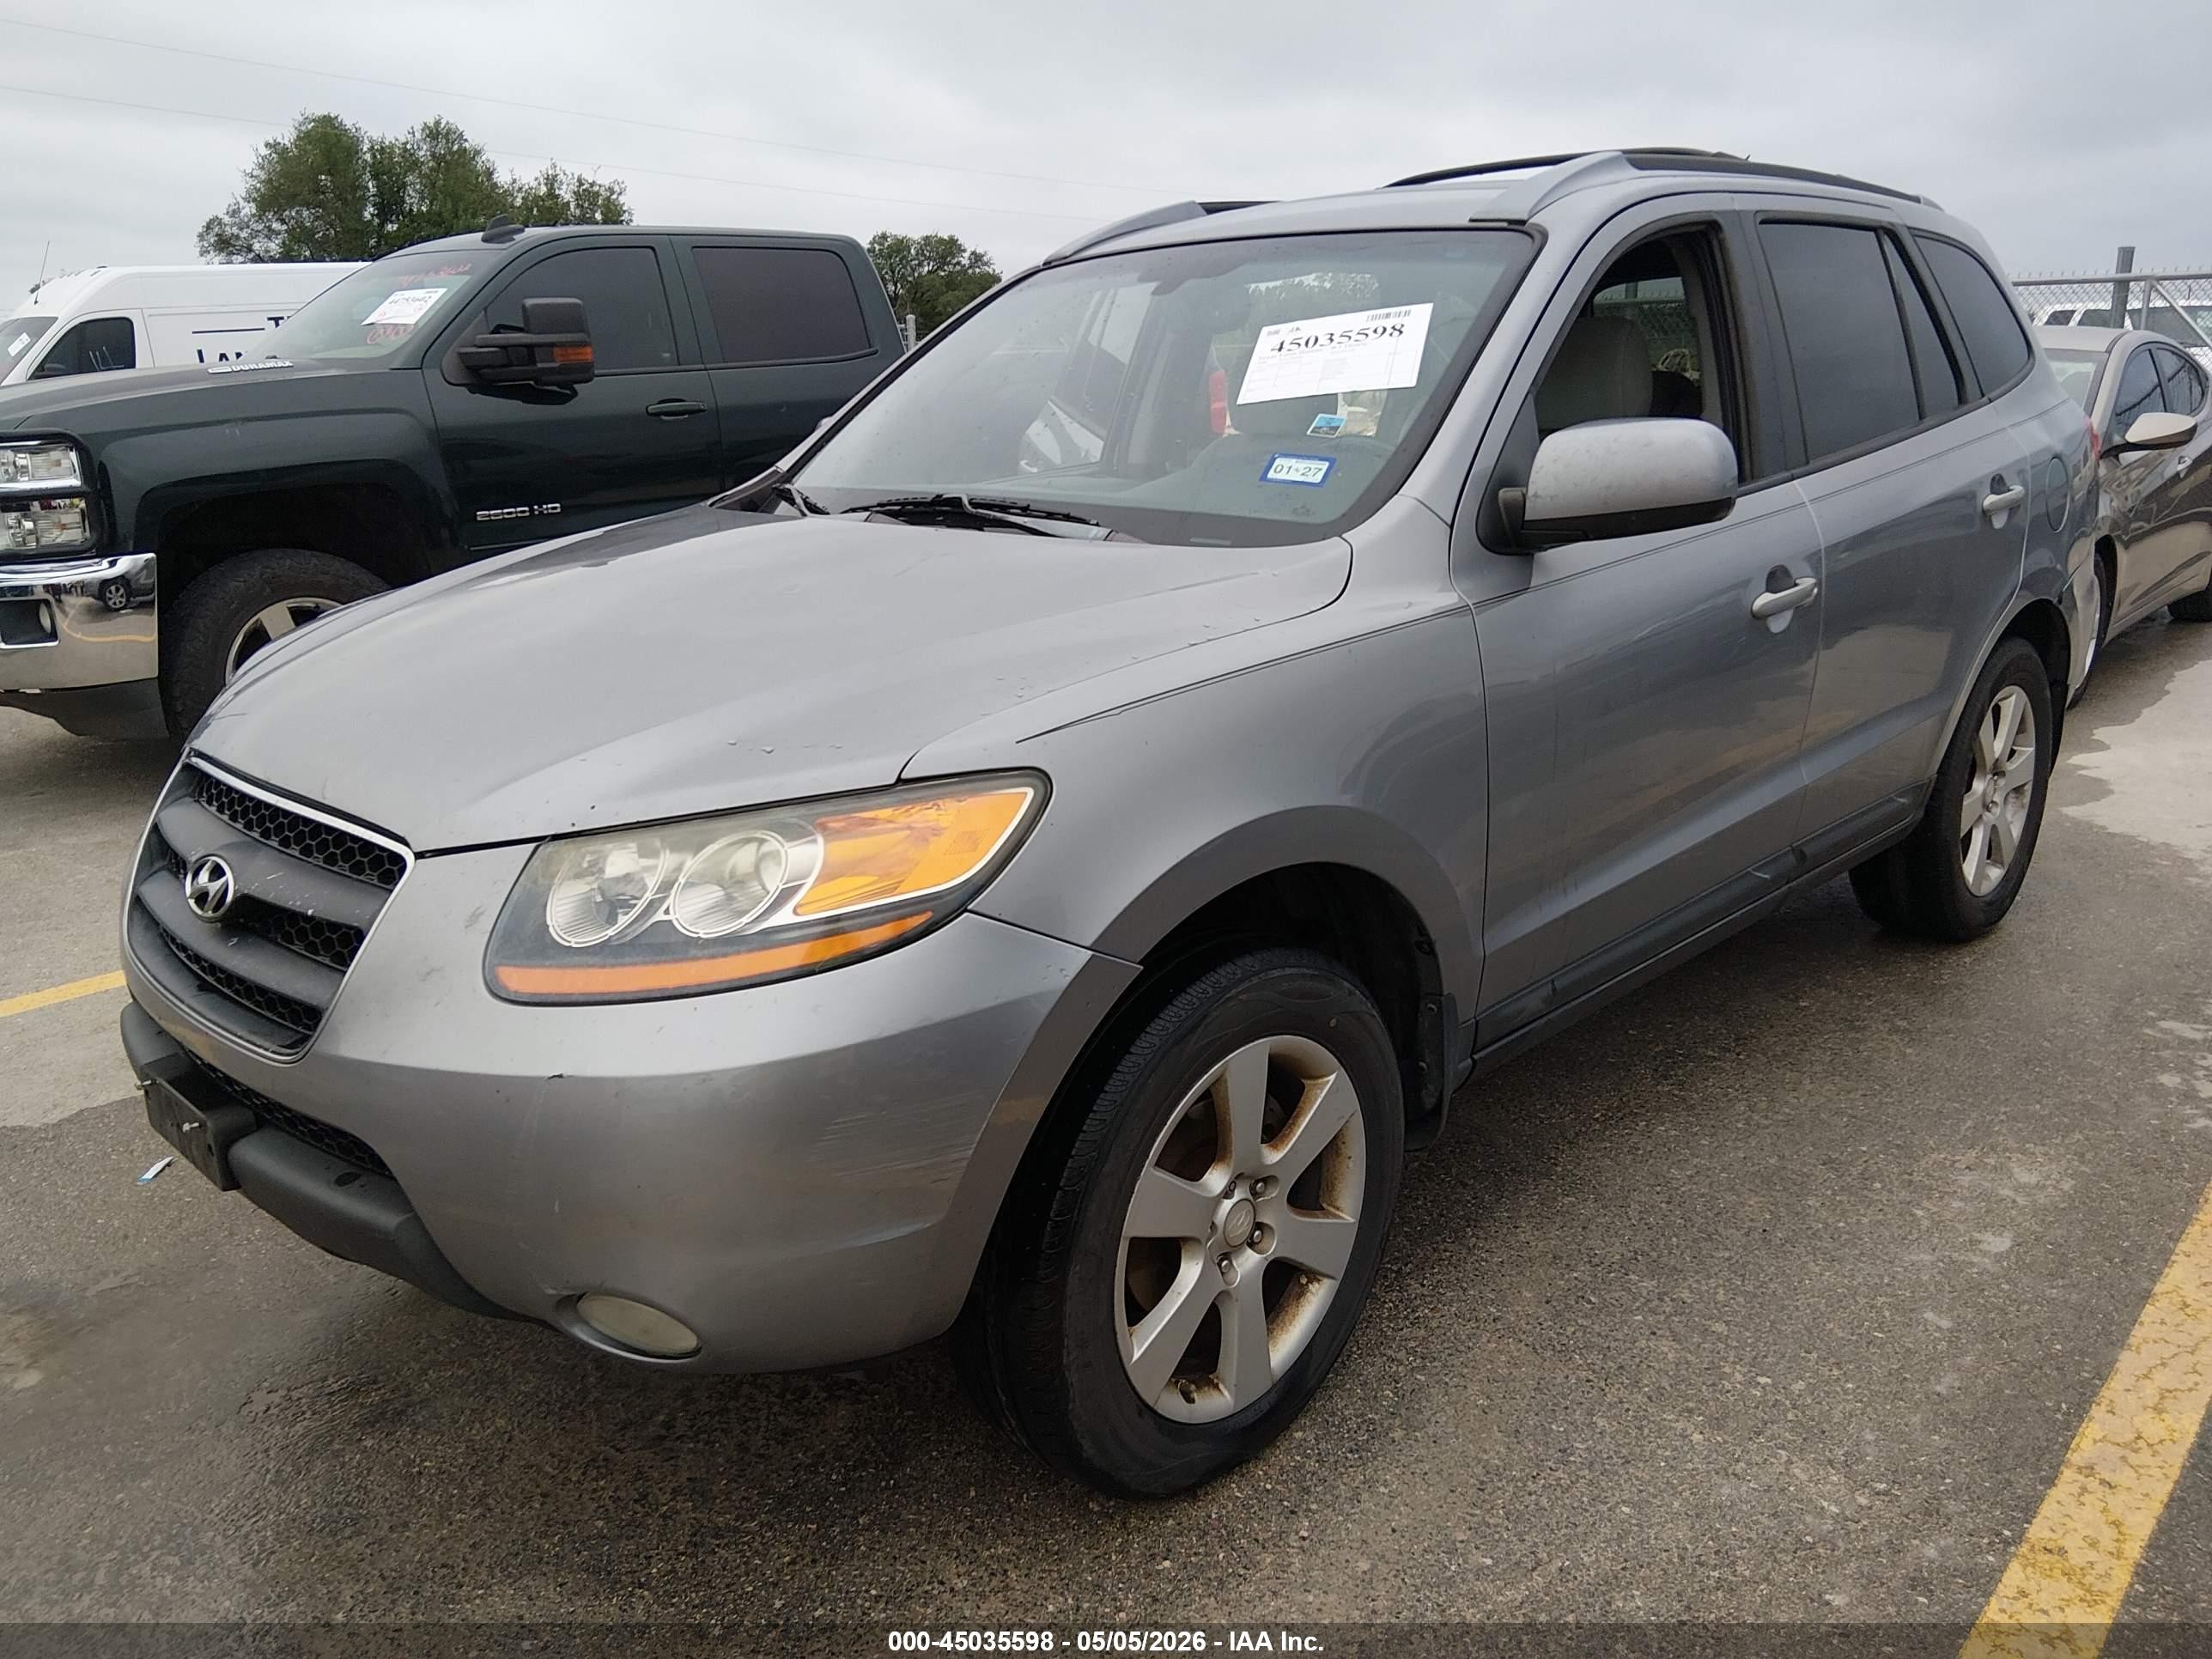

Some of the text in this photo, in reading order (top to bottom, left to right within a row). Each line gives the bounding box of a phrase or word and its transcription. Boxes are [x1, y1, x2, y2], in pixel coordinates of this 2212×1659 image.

[1270, 323, 1405, 353] 45035598
[477, 503, 561, 520] 2500 HD
